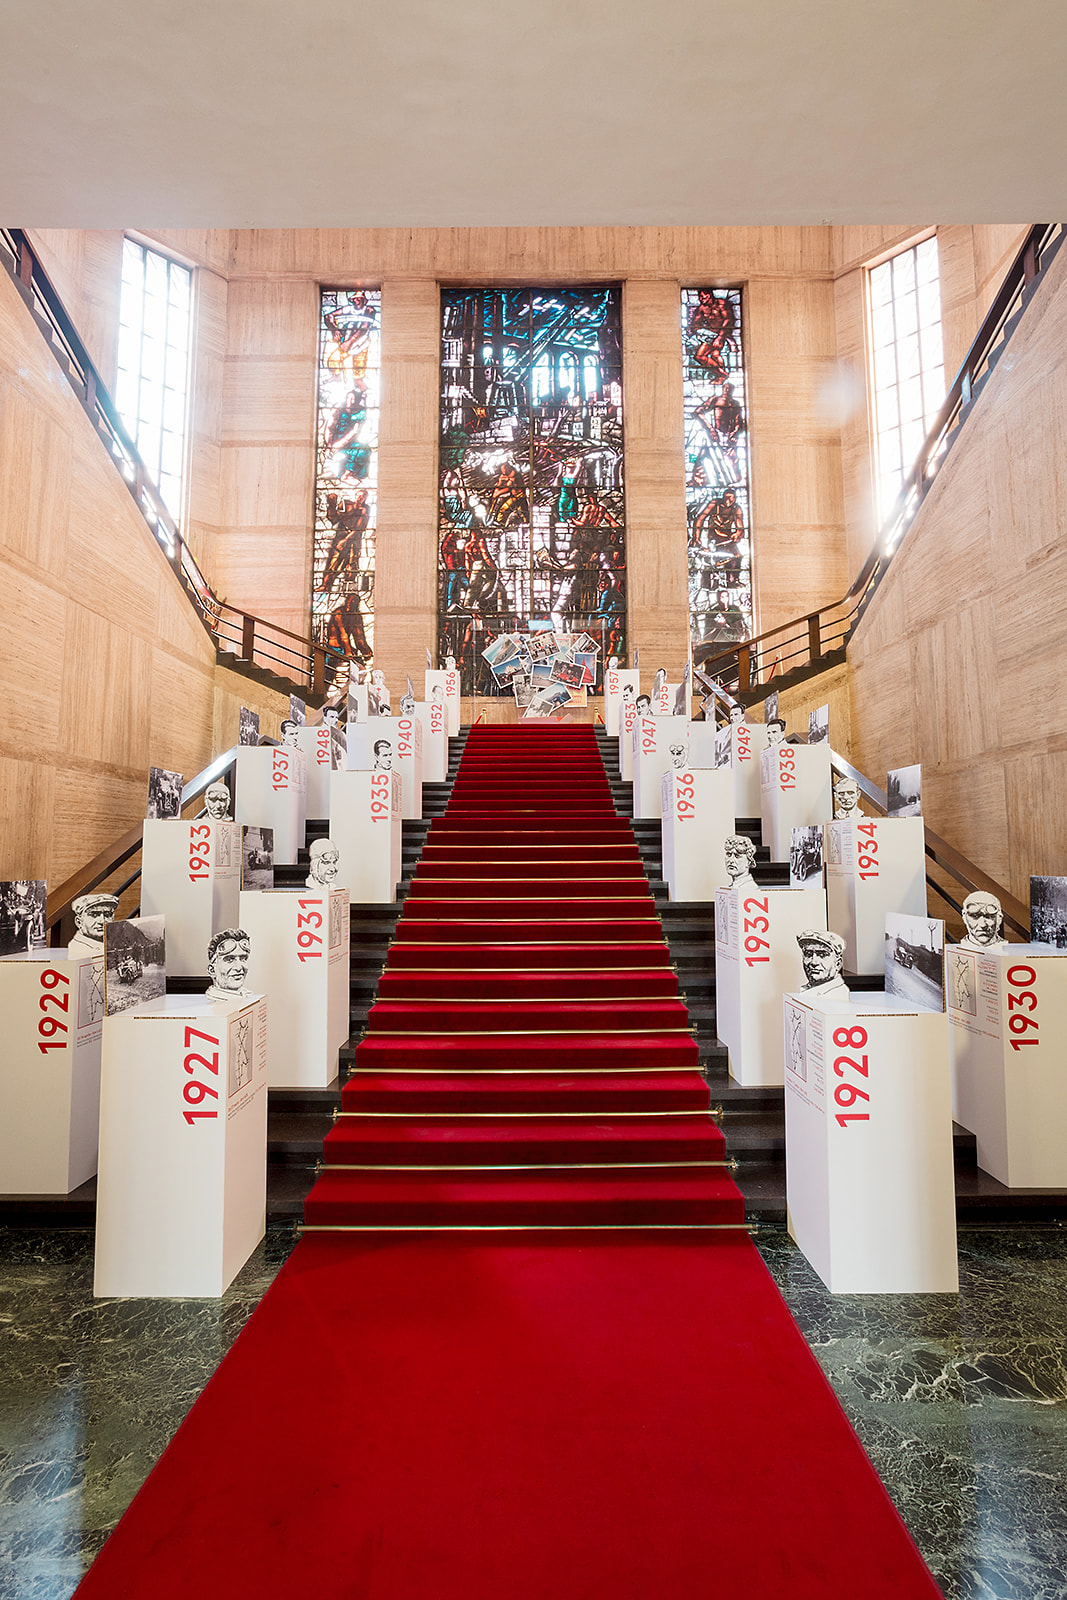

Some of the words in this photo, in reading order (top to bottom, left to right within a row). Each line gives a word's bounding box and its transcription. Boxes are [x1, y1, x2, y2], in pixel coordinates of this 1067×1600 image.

[445, 671, 456, 697] 1956
[609, 671, 619, 696] 1957
[397, 719, 413, 759] 1940
[430, 704, 443, 734] 1952
[624, 703, 637, 734] 1953
[641, 718, 657, 756] 1947
[316, 729, 330, 766] 1948
[737, 726, 752, 762] 1949
[272, 748, 289, 792] 1937
[778, 748, 796, 792] 1938
[370, 774, 389, 823] 1935
[676, 773, 695, 822] 1936
[188, 824, 211, 882] 1933
[857, 822, 879, 881] 1934
[296, 899, 323, 963] 1931
[743, 897, 770, 968] 1932
[37, 969, 70, 1054] 1929
[1006, 965, 1040, 1051] 1930
[182, 1025, 220, 1125] 1927
[832, 1025, 870, 1128] 1928
